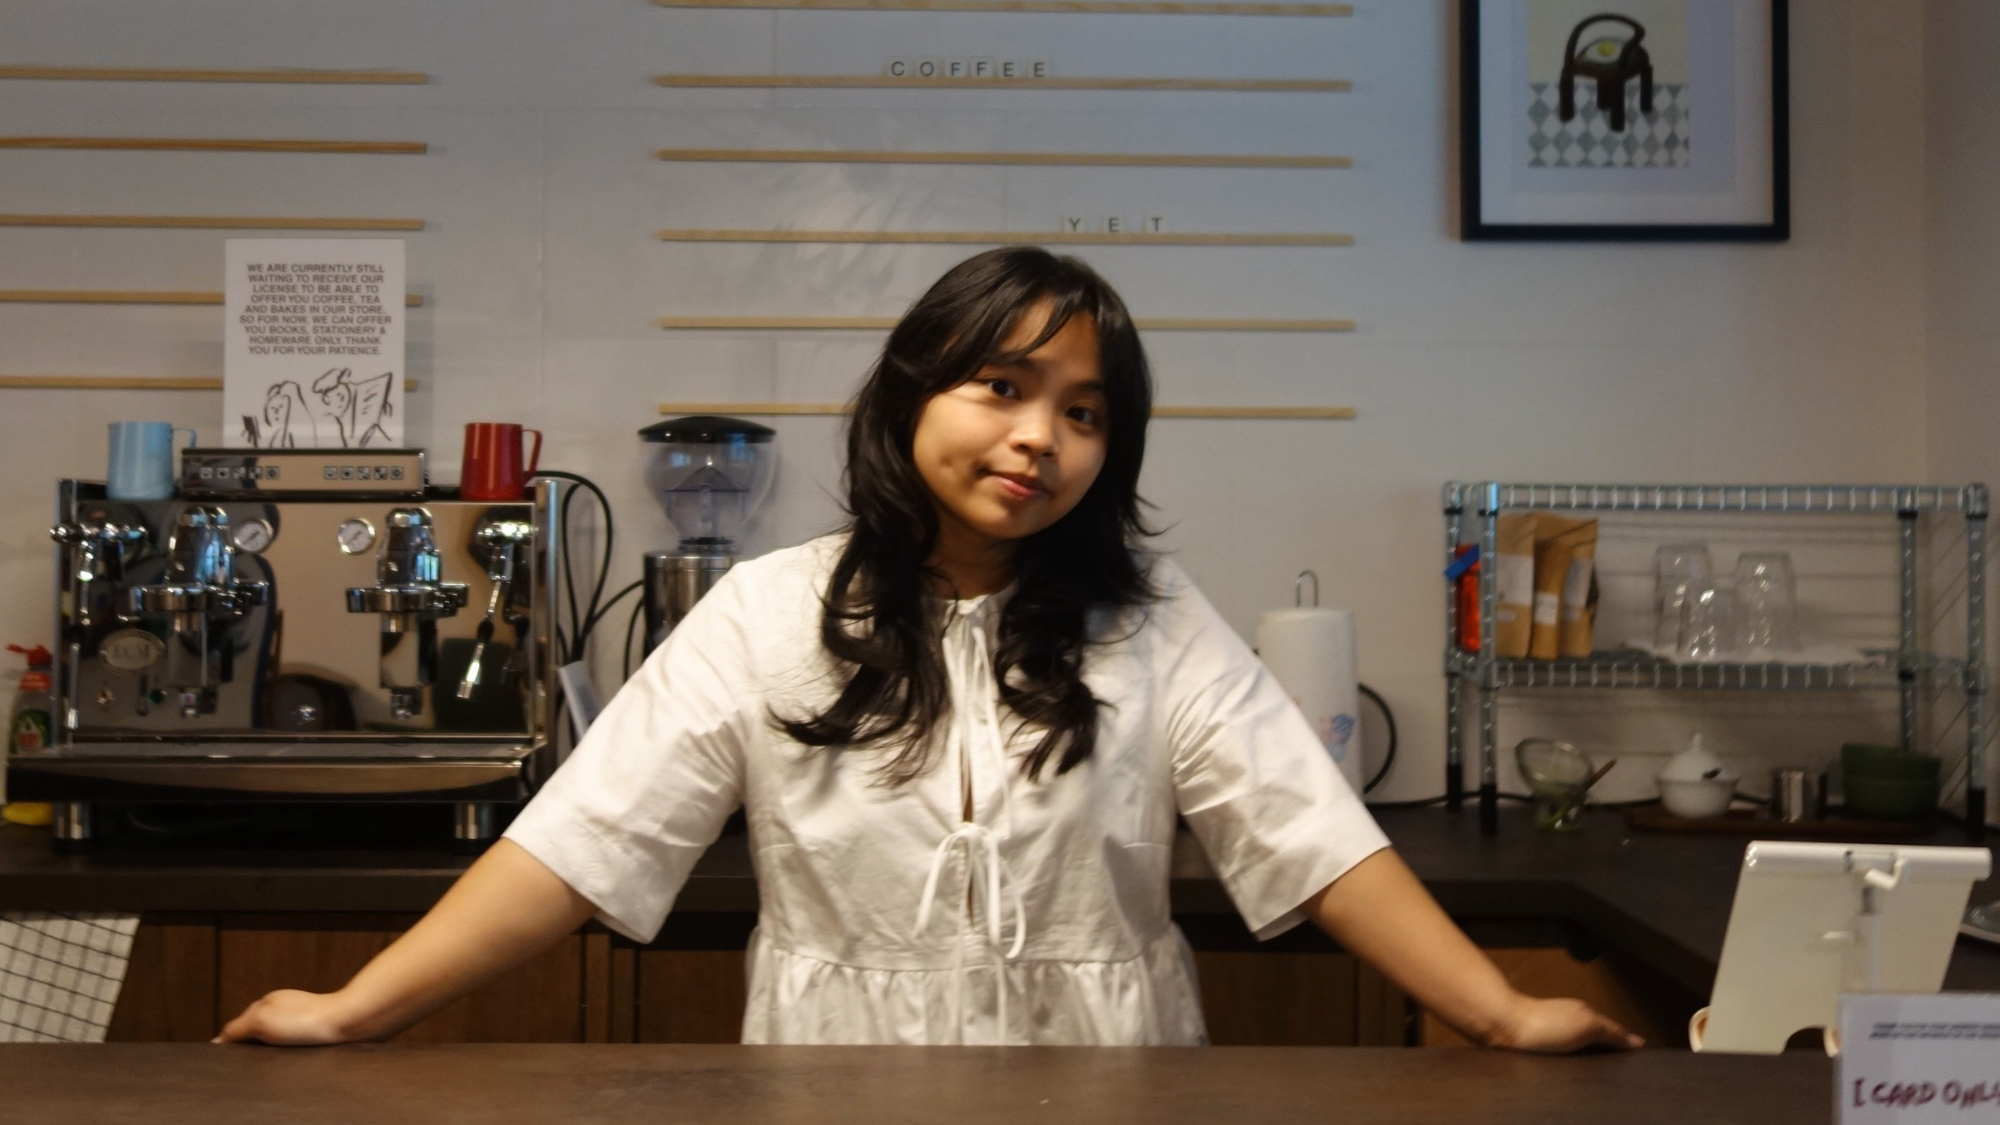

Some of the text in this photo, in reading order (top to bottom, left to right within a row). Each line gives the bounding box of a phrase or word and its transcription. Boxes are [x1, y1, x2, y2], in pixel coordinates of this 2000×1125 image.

[890, 60, 1046, 77] COFFEE
[1068, 217, 1163, 233] YET
[247, 264, 385, 273] WE ARE CURRENTLY STILL
[248, 274, 384, 283] WAITING TO RECEIVE OUR
[253, 285, 378, 293] LICENSE TO BE ABLE TO
[251, 295, 286, 303] OFFER
[289, 295, 309, 303] YOU
[361, 295, 380, 303] TEA
[245, 305, 267, 313] AND
[271, 305, 305, 313] BAKES
[310, 305, 319, 313] IN
[323, 305, 345, 313] OUR
[240, 316, 254, 324] SO
[258, 316, 278, 324] FOR
[312, 316, 328, 324] WE
[331, 316, 353, 324] CAN
[357, 316, 391, 324] OFFER
[245, 326, 265, 334] YOU
[312, 326, 375, 334] STATIONERY
[380, 326, 386, 334] &
[250, 336, 311, 344] HOMEWARE
[346, 336, 381, 344] THANK
